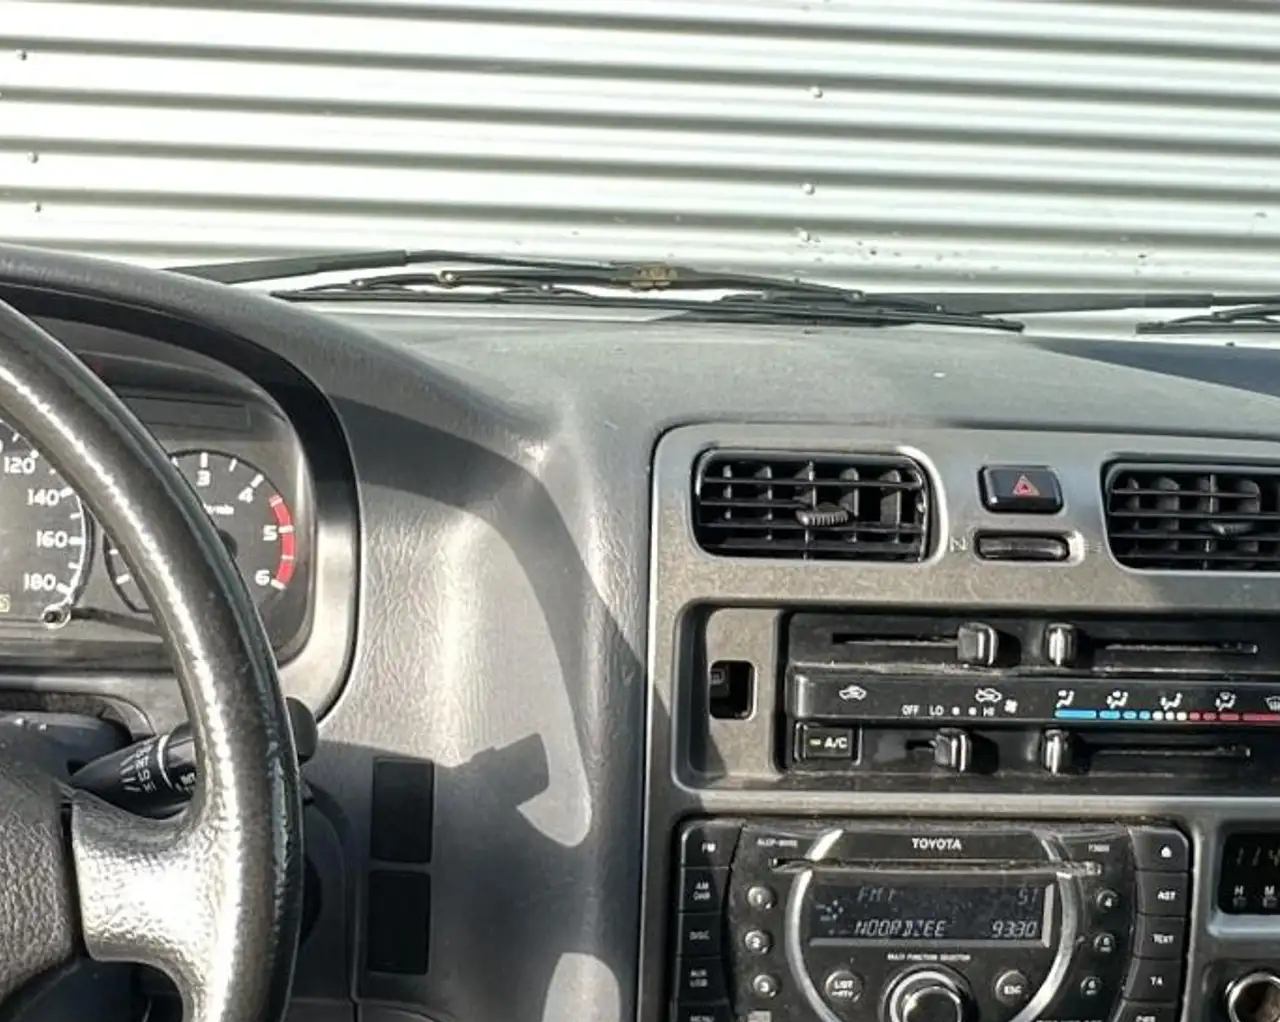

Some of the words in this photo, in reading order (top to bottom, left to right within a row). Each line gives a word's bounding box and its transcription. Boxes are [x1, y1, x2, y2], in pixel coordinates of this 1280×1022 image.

[4, 457, 36, 474] 120
[195, 469, 211, 487] 3
[27, 488, 60, 506] 140
[238, 486, 254, 503] 4
[36, 531, 68, 547] 160
[262, 525, 278, 541] 5
[23, 573, 56, 591] 180
[255, 570, 270, 585] 6
[901, 705, 920, 717] OFF
[929, 704, 945, 717] LO
[823, 736, 849, 749] A/C
[911, 837, 962, 850] TOYOTA
[1233, 885, 1245, 897] H
[1263, 884, 1276, 897] M
